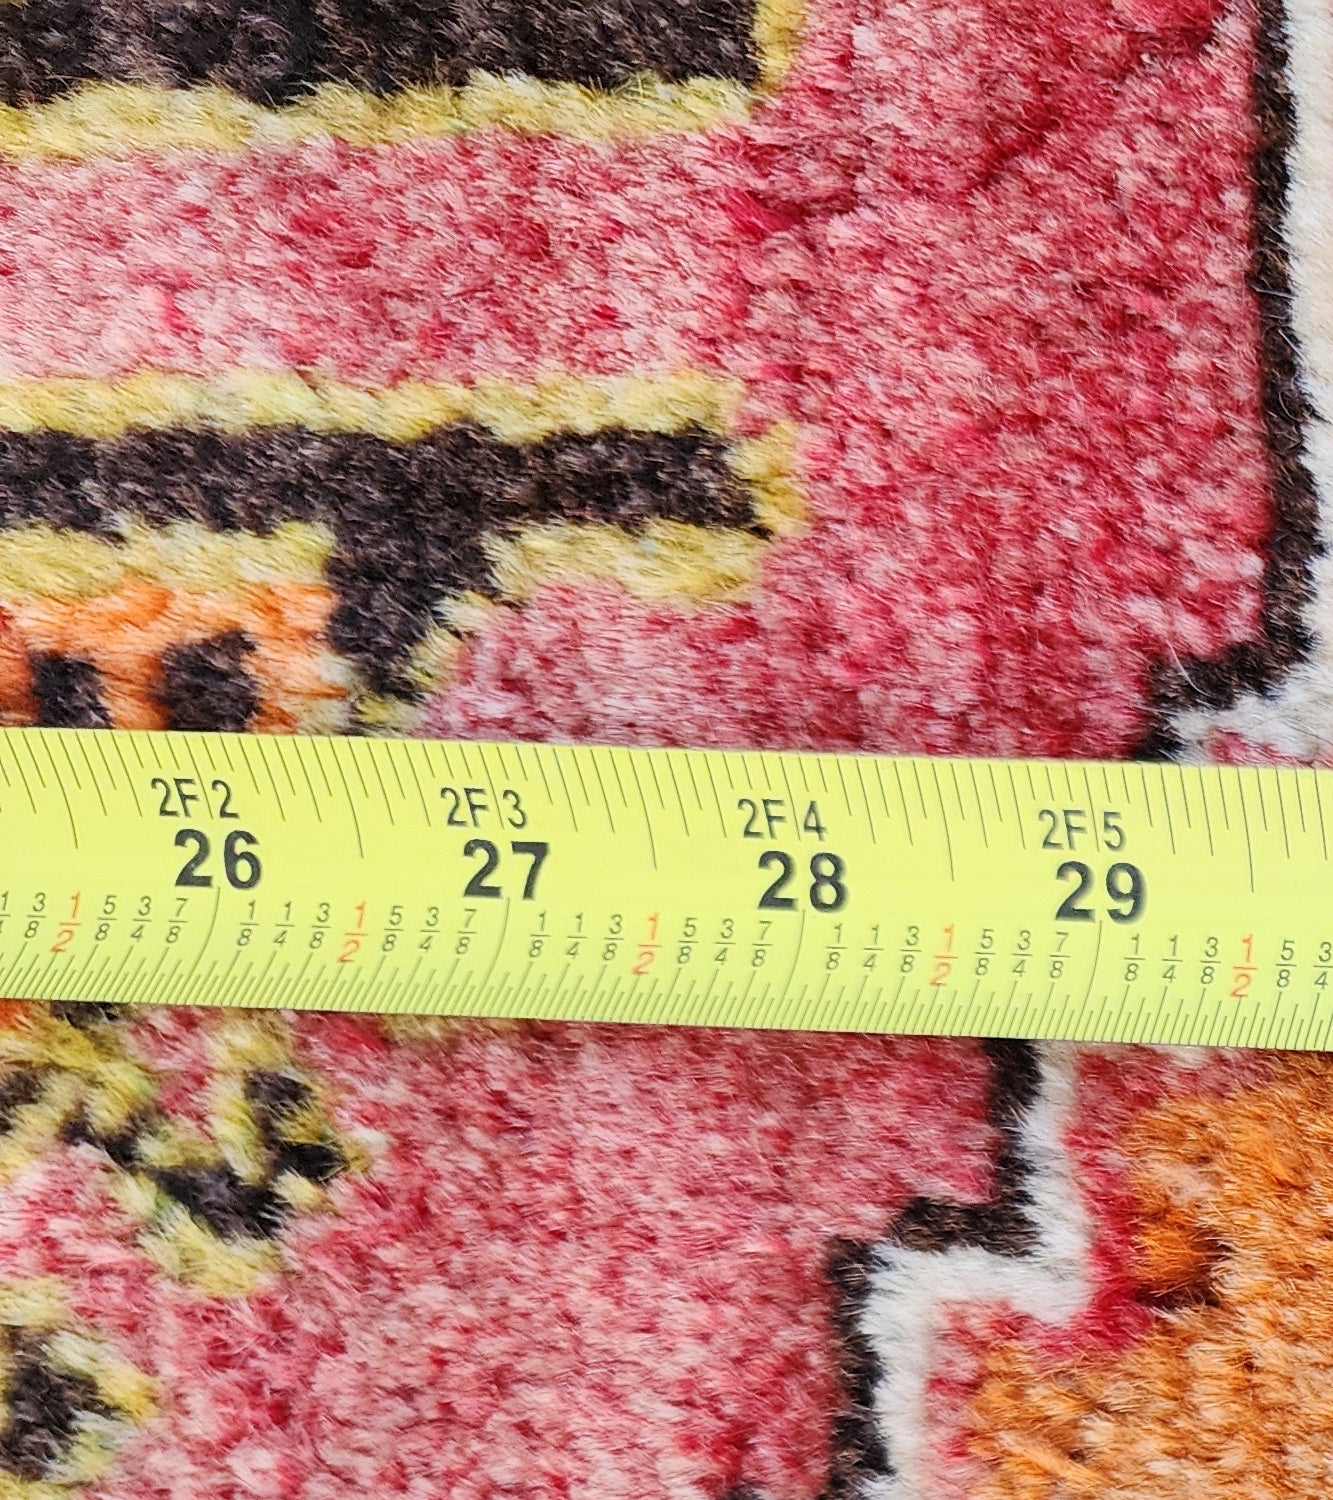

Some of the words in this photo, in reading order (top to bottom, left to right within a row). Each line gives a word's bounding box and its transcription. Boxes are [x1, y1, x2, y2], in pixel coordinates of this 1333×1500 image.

[173, 827, 264, 892] 26
[461, 837, 552, 902] 27
[756, 849, 850, 915] 28
[1053, 860, 1148, 926] 29
